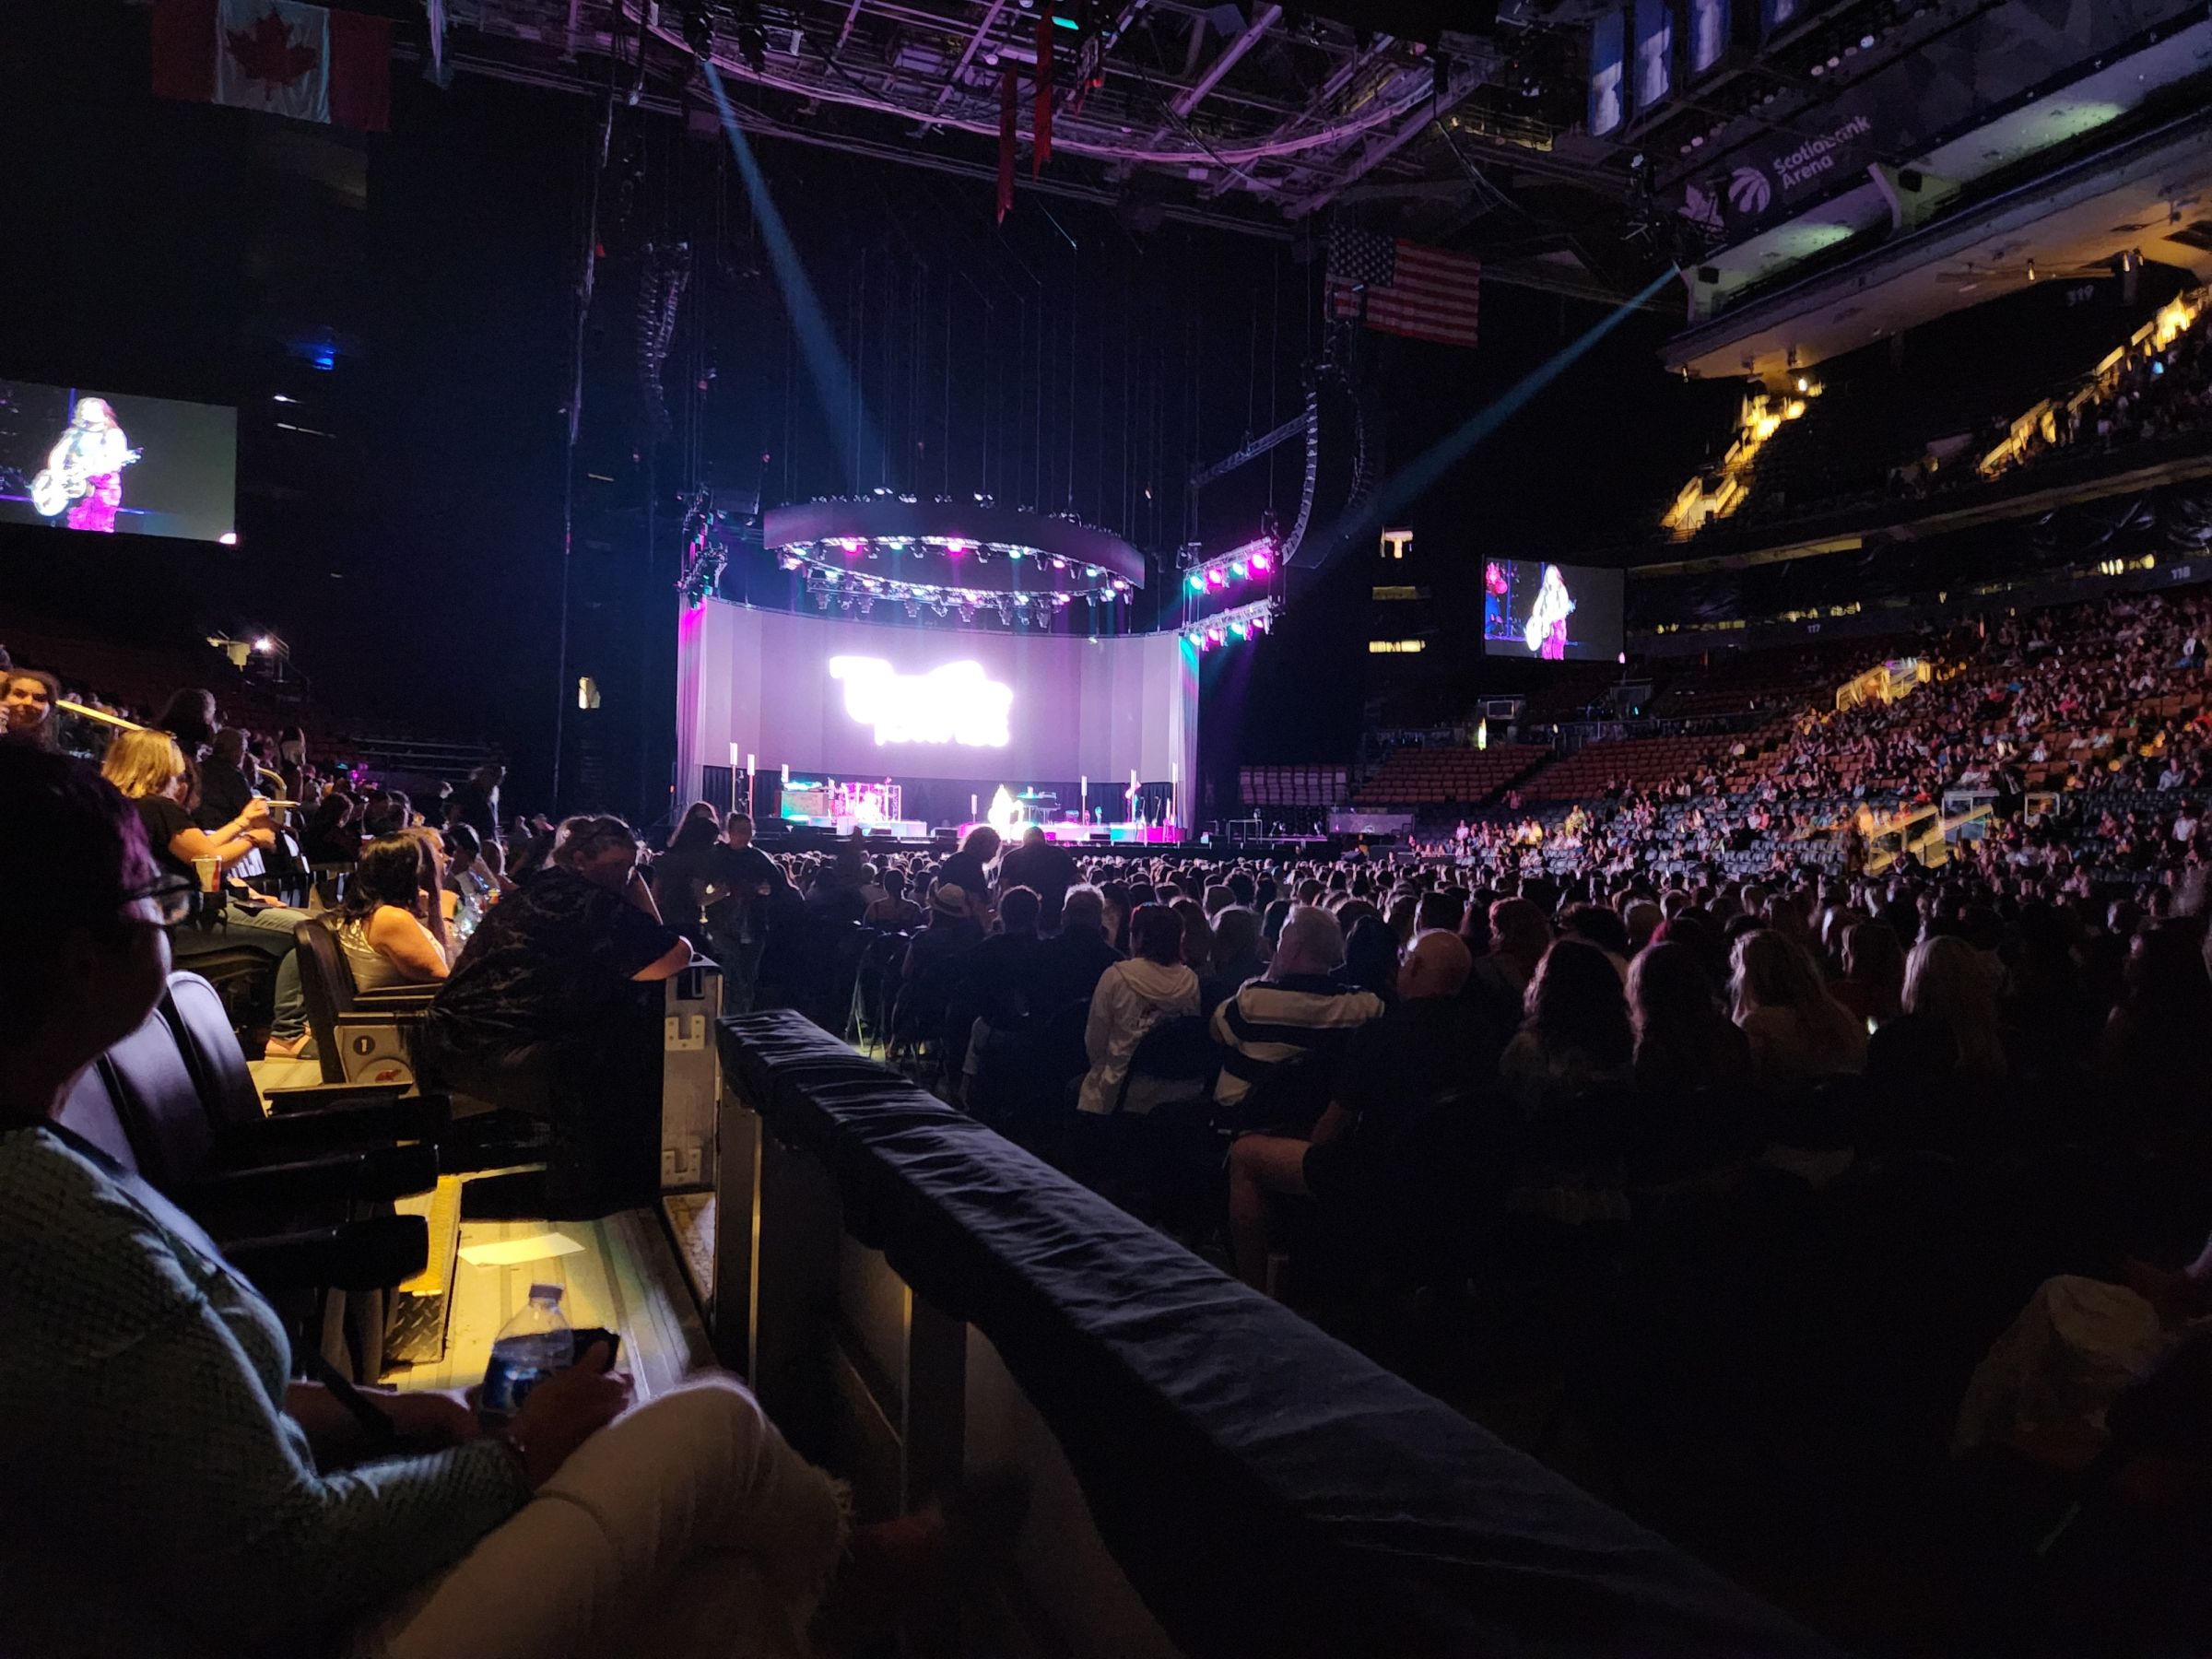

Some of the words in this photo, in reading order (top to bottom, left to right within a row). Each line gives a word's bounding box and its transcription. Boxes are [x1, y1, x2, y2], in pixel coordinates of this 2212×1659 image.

[1773, 115, 1871, 175] Scotiabank
[1783, 155, 1834, 190] Arena
[1806, 623, 1821, 634] 117
